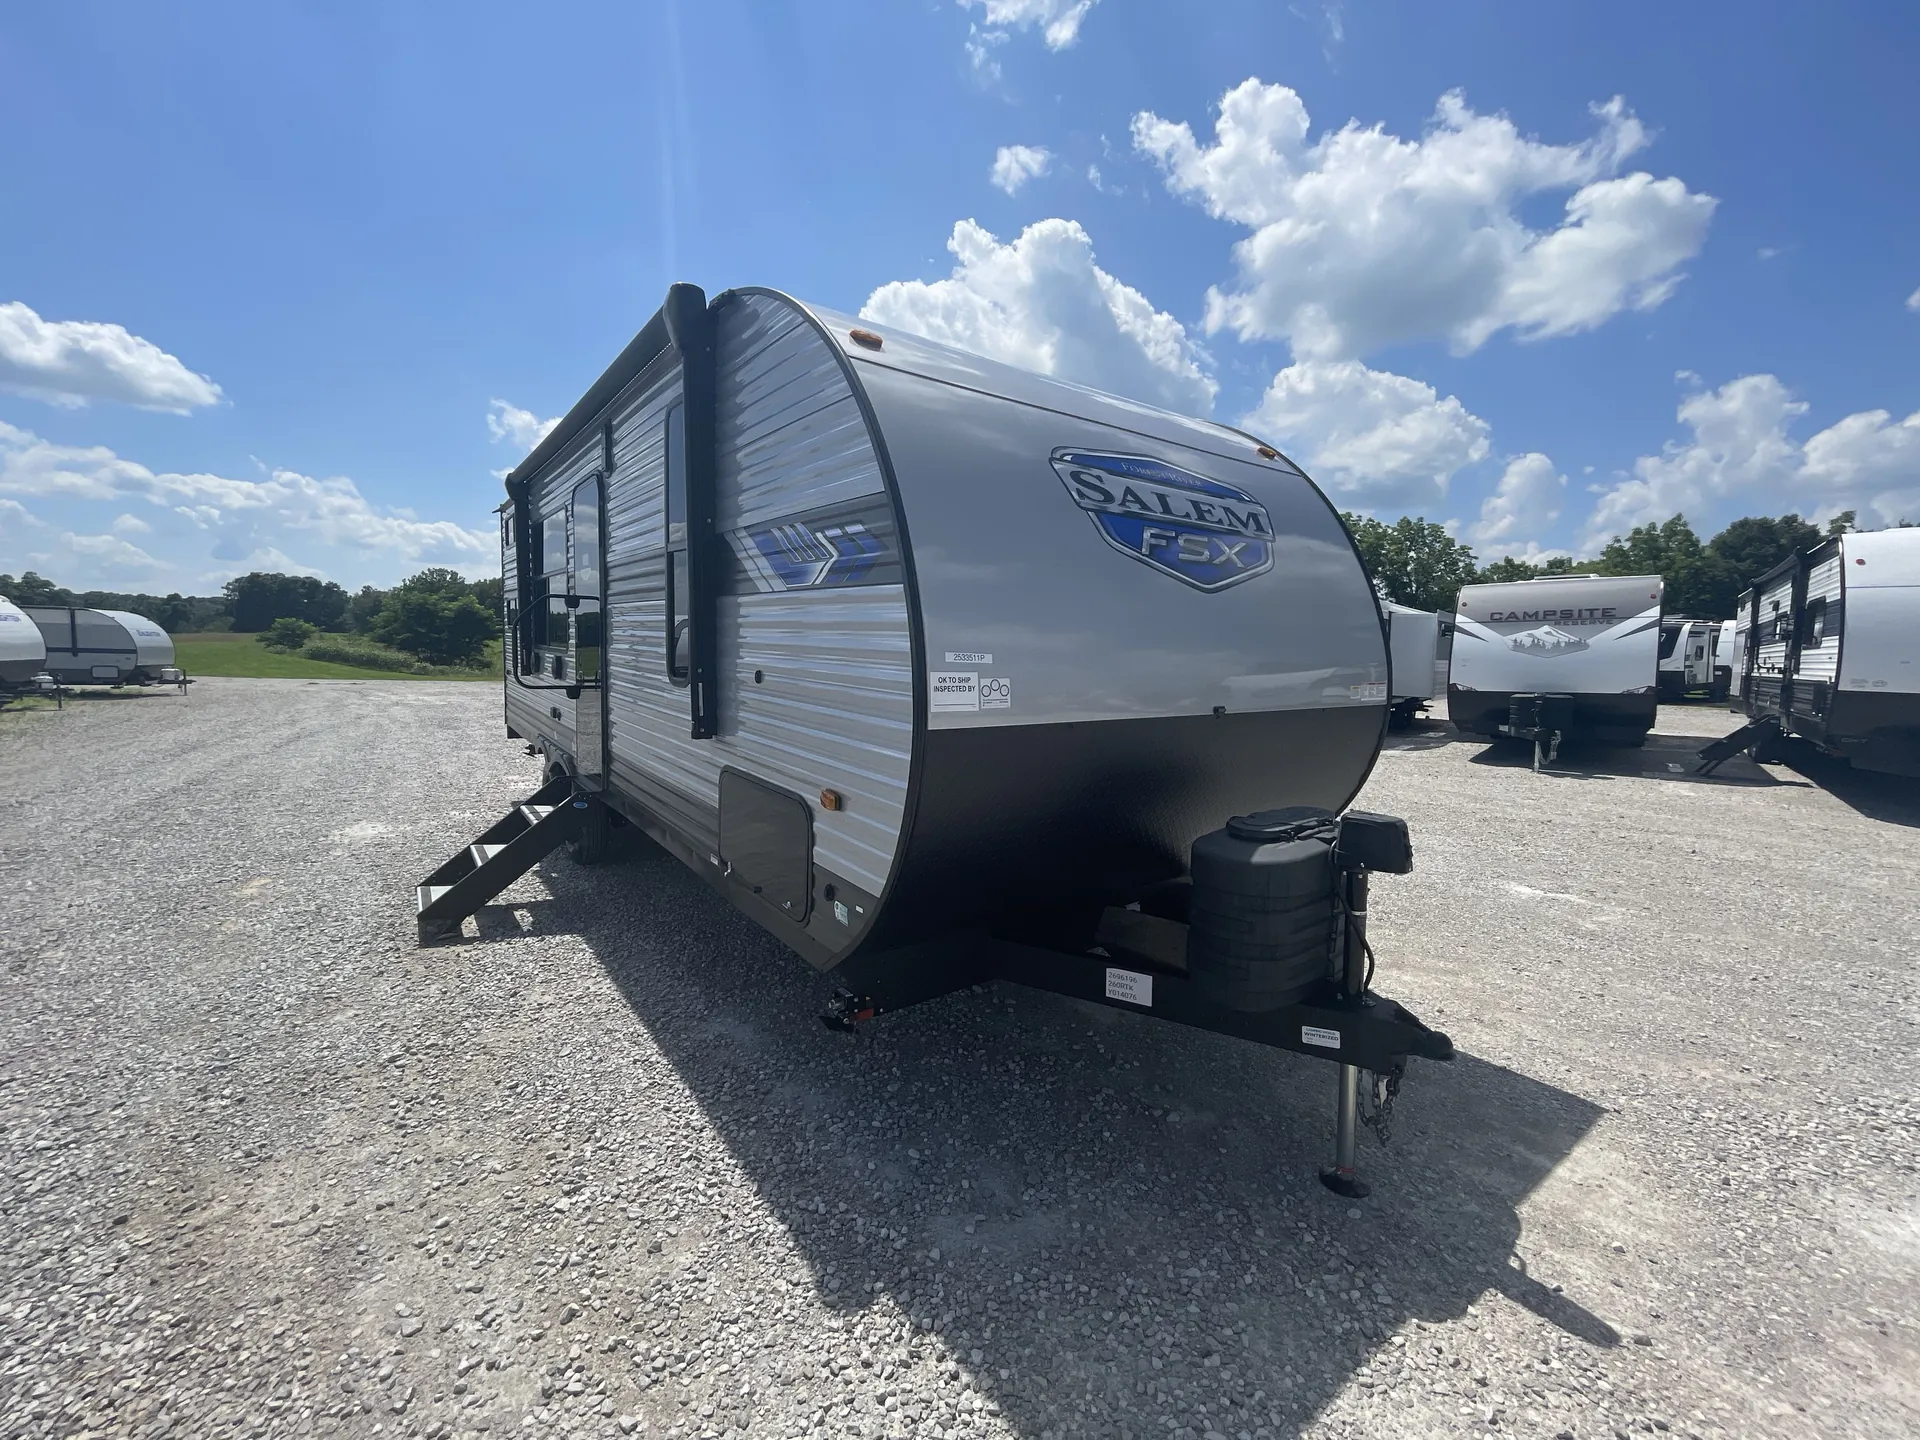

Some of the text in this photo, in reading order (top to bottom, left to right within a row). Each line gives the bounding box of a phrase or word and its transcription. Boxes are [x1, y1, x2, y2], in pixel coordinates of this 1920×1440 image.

[1069, 470, 1275, 536] SALEM
[1141, 526, 1247, 568] FSX
[1490, 607, 1617, 621] CAMPSITE
[953, 653, 986, 662] 2533511P
[938, 676, 972, 684] OK TO SHIP
[933, 685, 976, 693] INSPECTED BY
[1108, 972, 1138, 983] 2696196
[1108, 980, 1134, 991] 260RTK
[1108, 989, 1137, 1000] Y014076
[1304, 1032, 1338, 1041] WINTERIZED
